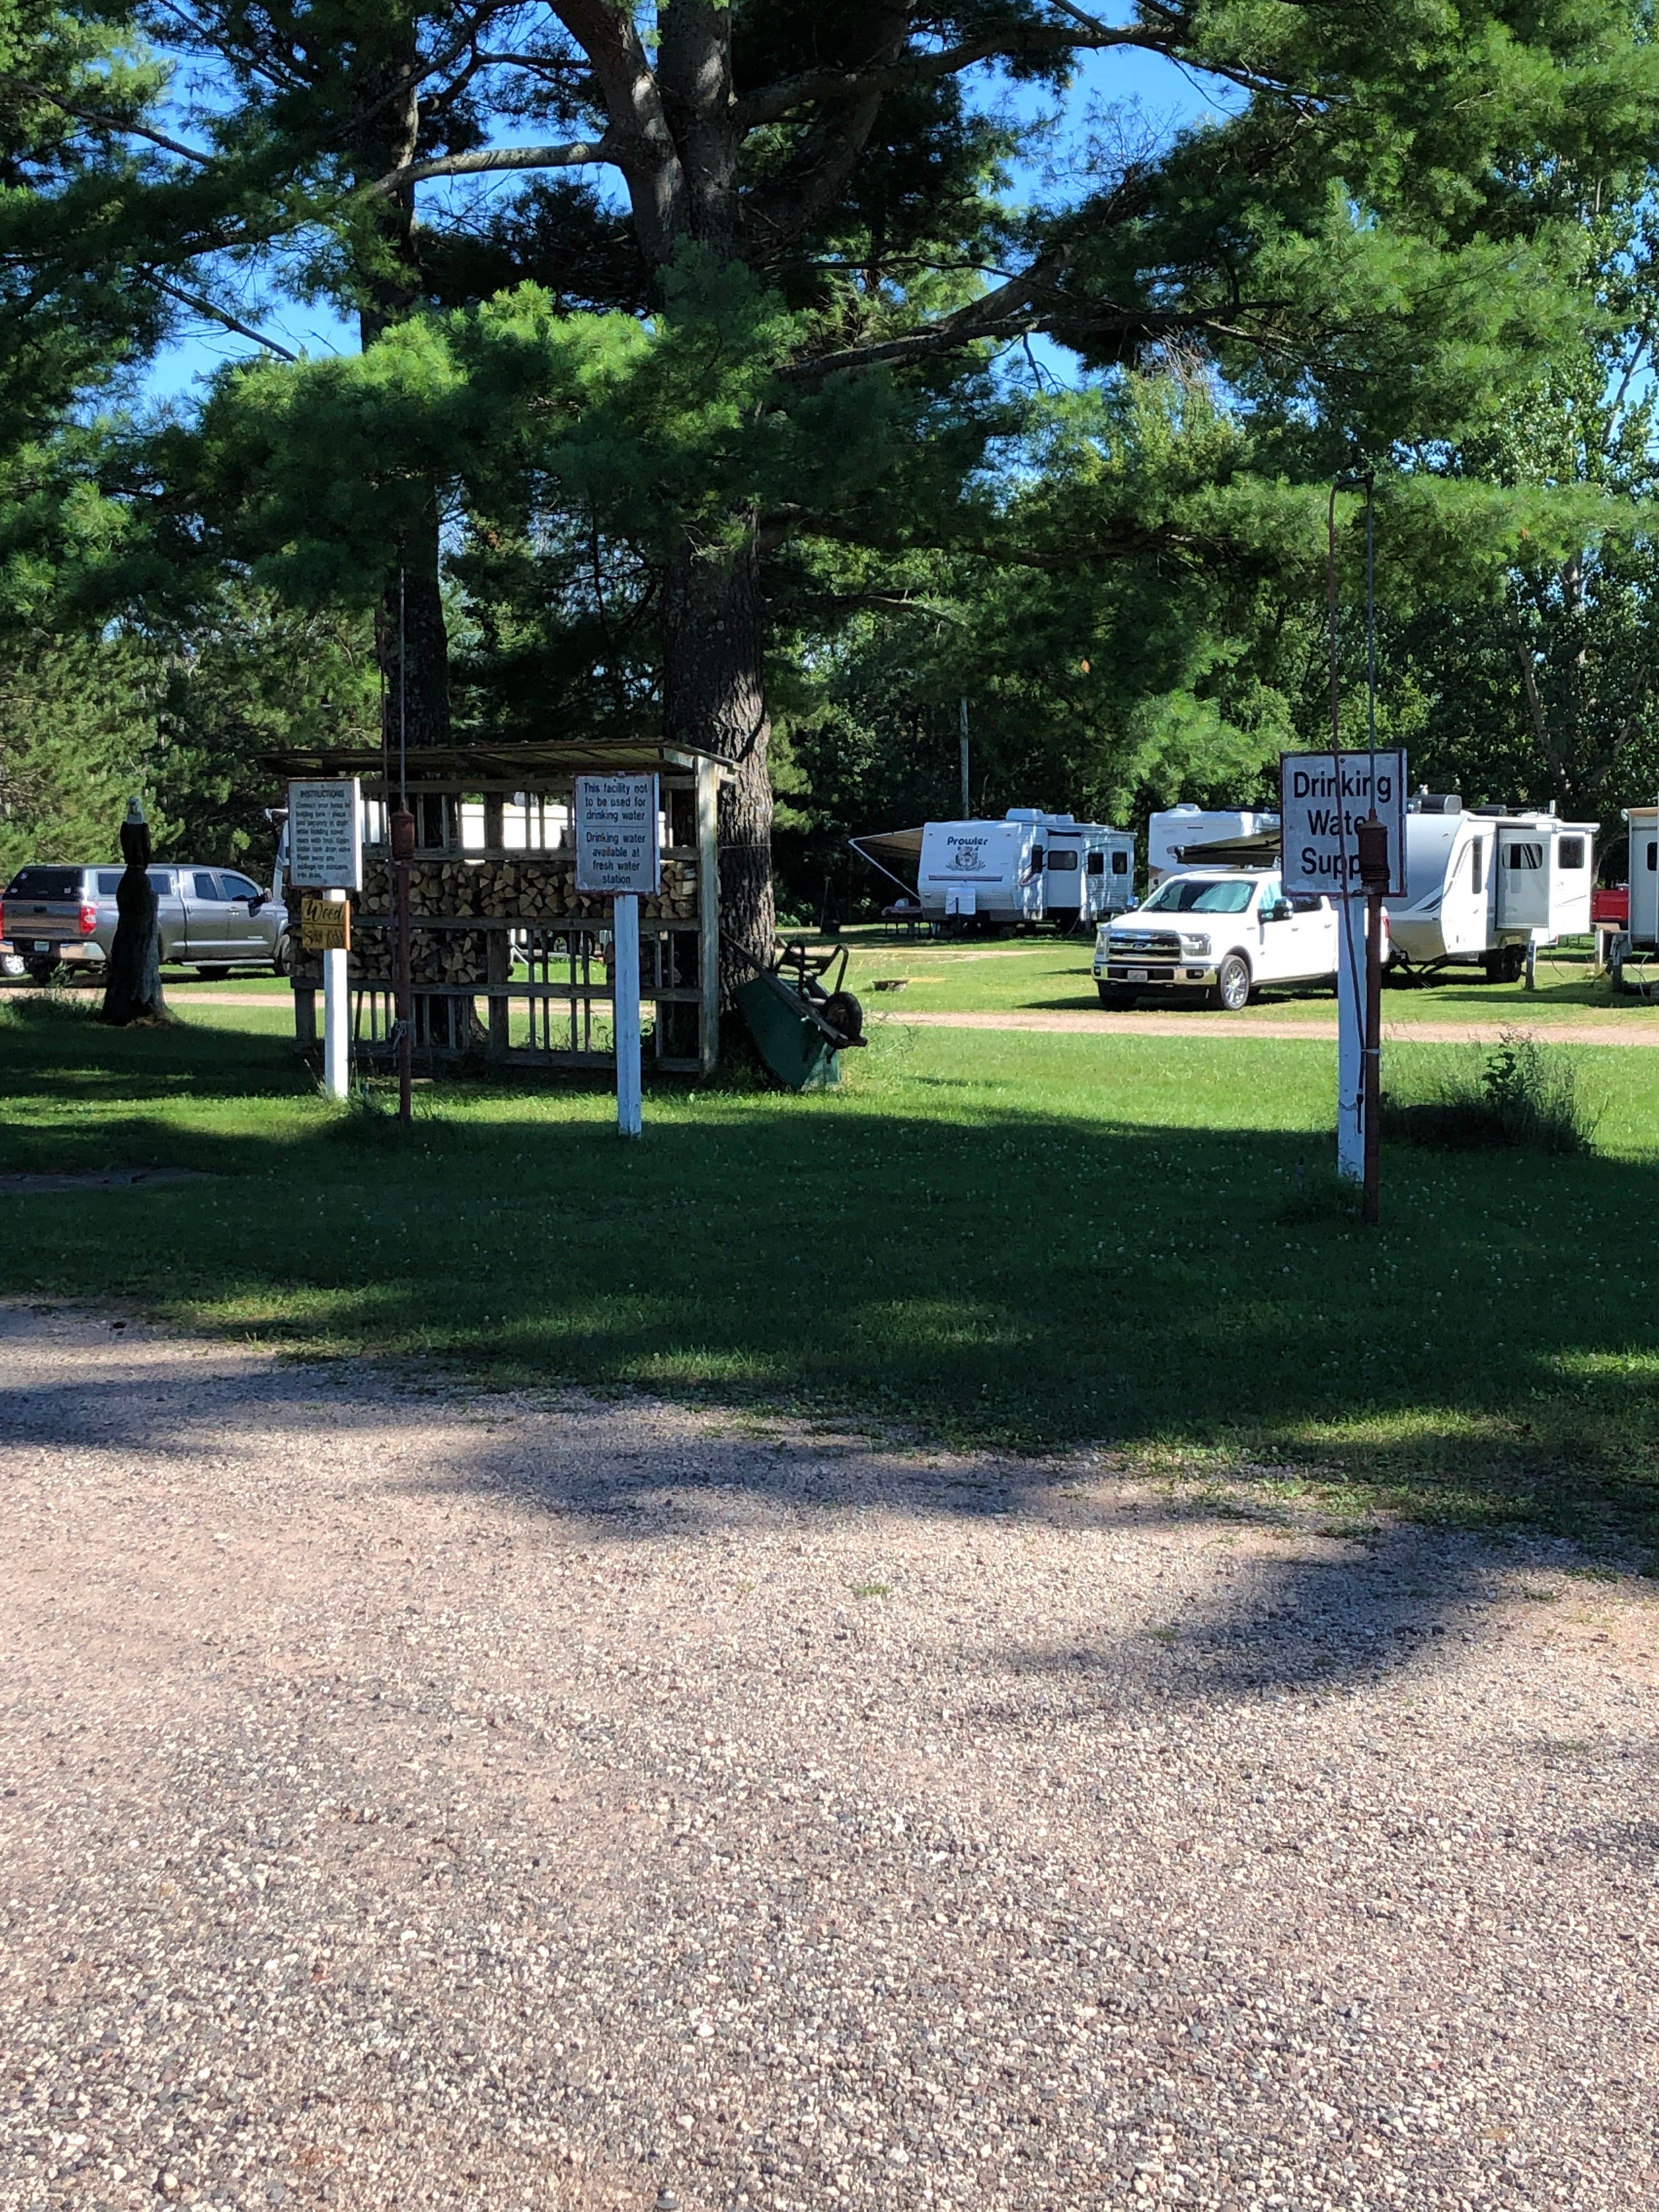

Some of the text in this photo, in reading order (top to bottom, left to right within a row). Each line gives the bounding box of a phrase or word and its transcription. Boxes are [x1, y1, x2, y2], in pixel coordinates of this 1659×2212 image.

[584, 782, 648, 795] This facility not
[1293, 770, 1392, 804] Drinking
[300, 789, 345, 798] INSTRUCTIONS
[585, 796, 646, 807] to be used for
[586, 810, 645, 823] drinking water
[1307, 809, 1367, 836] Wate
[586, 832, 646, 845] Drinking water
[947, 836, 989, 845] Prowler
[592, 847, 640, 857] available at
[592, 860, 640, 871] fresh water
[1301, 847, 1361, 880] Supp
[602, 874, 630, 884] station
